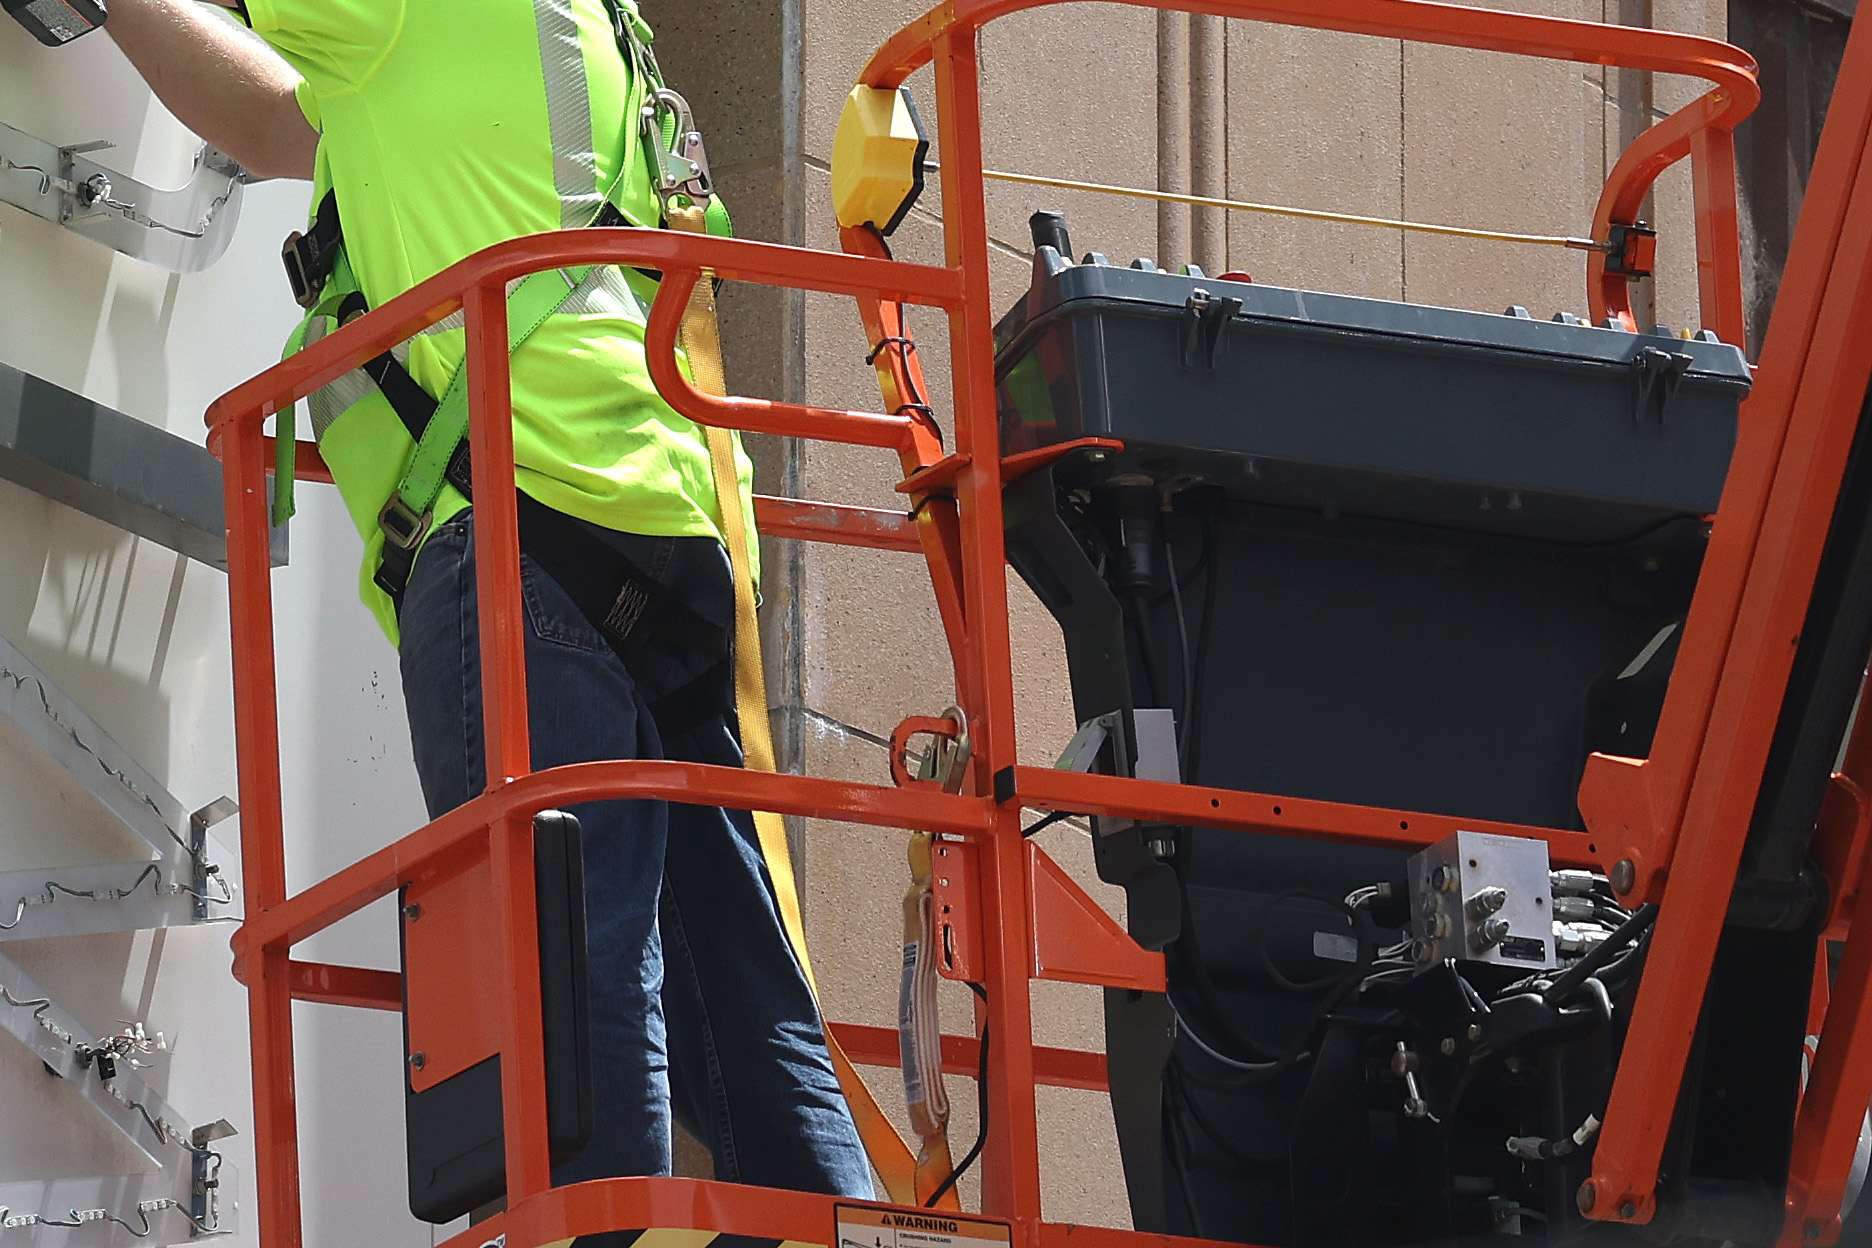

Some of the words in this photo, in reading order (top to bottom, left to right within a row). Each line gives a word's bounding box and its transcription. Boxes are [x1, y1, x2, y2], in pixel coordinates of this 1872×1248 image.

[893, 1214, 958, 1232] WARNING
[899, 1232, 928, 1242] CRUSHING
[929, 1236, 952, 1244] HAZARD
